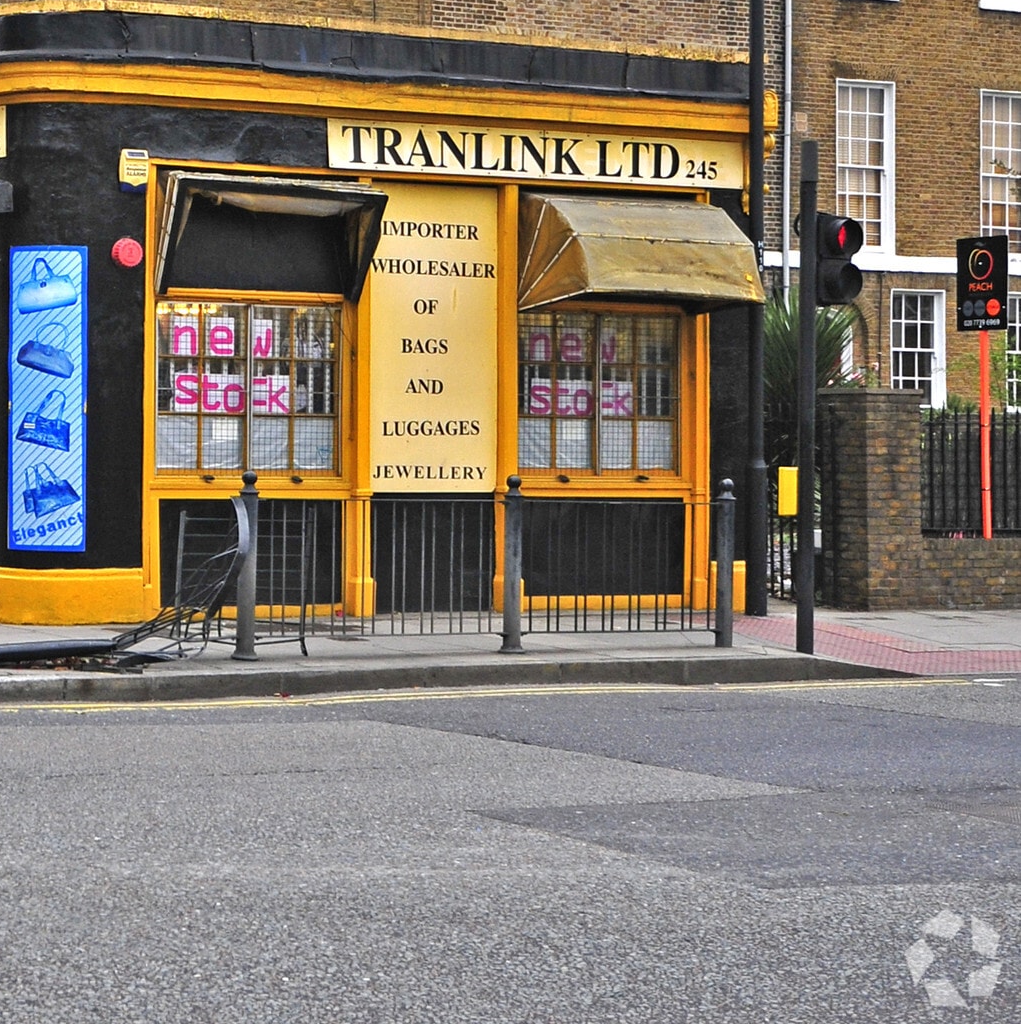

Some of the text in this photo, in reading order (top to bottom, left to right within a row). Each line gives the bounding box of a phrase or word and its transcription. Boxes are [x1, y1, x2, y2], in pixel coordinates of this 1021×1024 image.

[341, 125, 718, 180] TRANLINK LTD 245
[382, 220, 479, 241] IMPORTER
[371, 258, 496, 279] WHOLESALER
[969, 282, 993, 292] PEACH
[413, 299, 439, 314] OF
[172, 325, 273, 358] new
[401, 338, 449, 354] BAGS
[405, 378, 445, 395] AND
[382, 420, 480, 437] LUGGAGES
[372, 465, 488, 480] JEWELLERY
